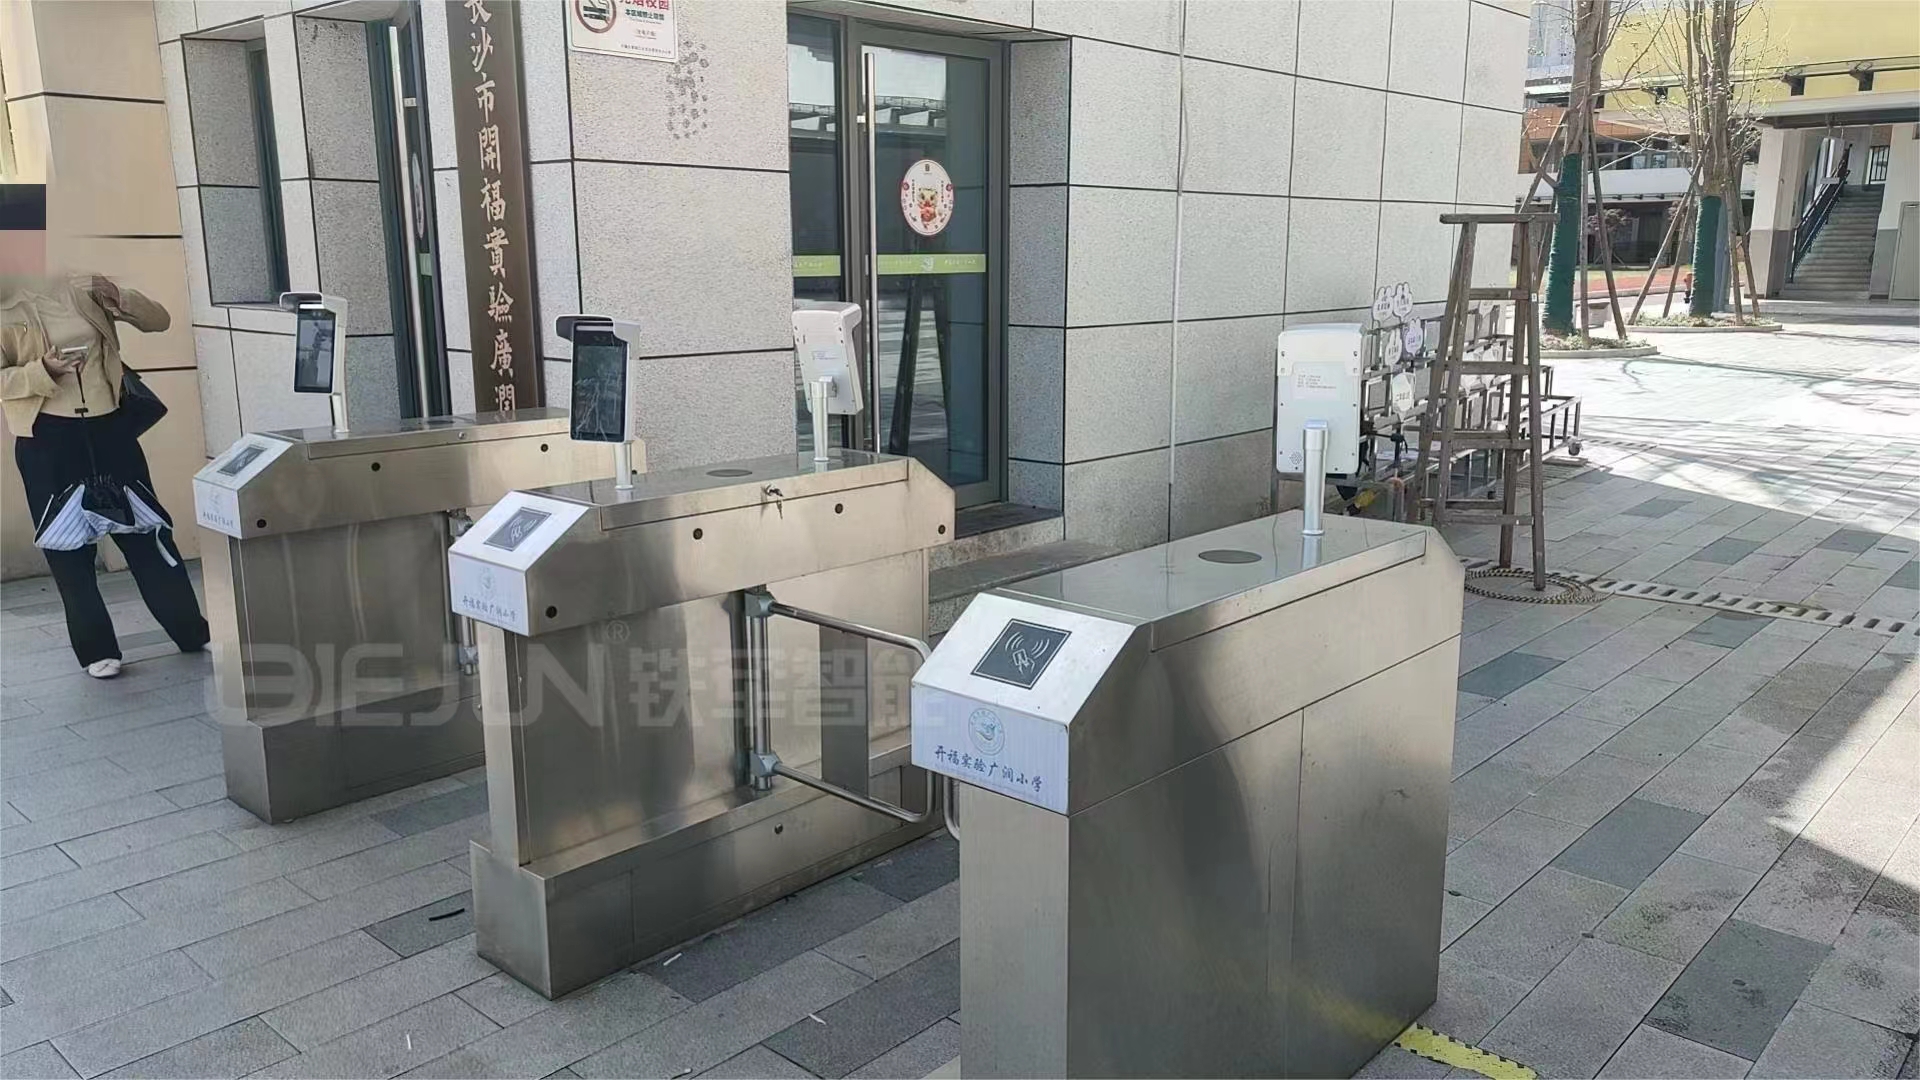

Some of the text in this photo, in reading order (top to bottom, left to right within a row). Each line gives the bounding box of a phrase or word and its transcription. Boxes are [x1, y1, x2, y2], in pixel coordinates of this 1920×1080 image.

[934, 745, 1042, 793] 开福实验广润小学
